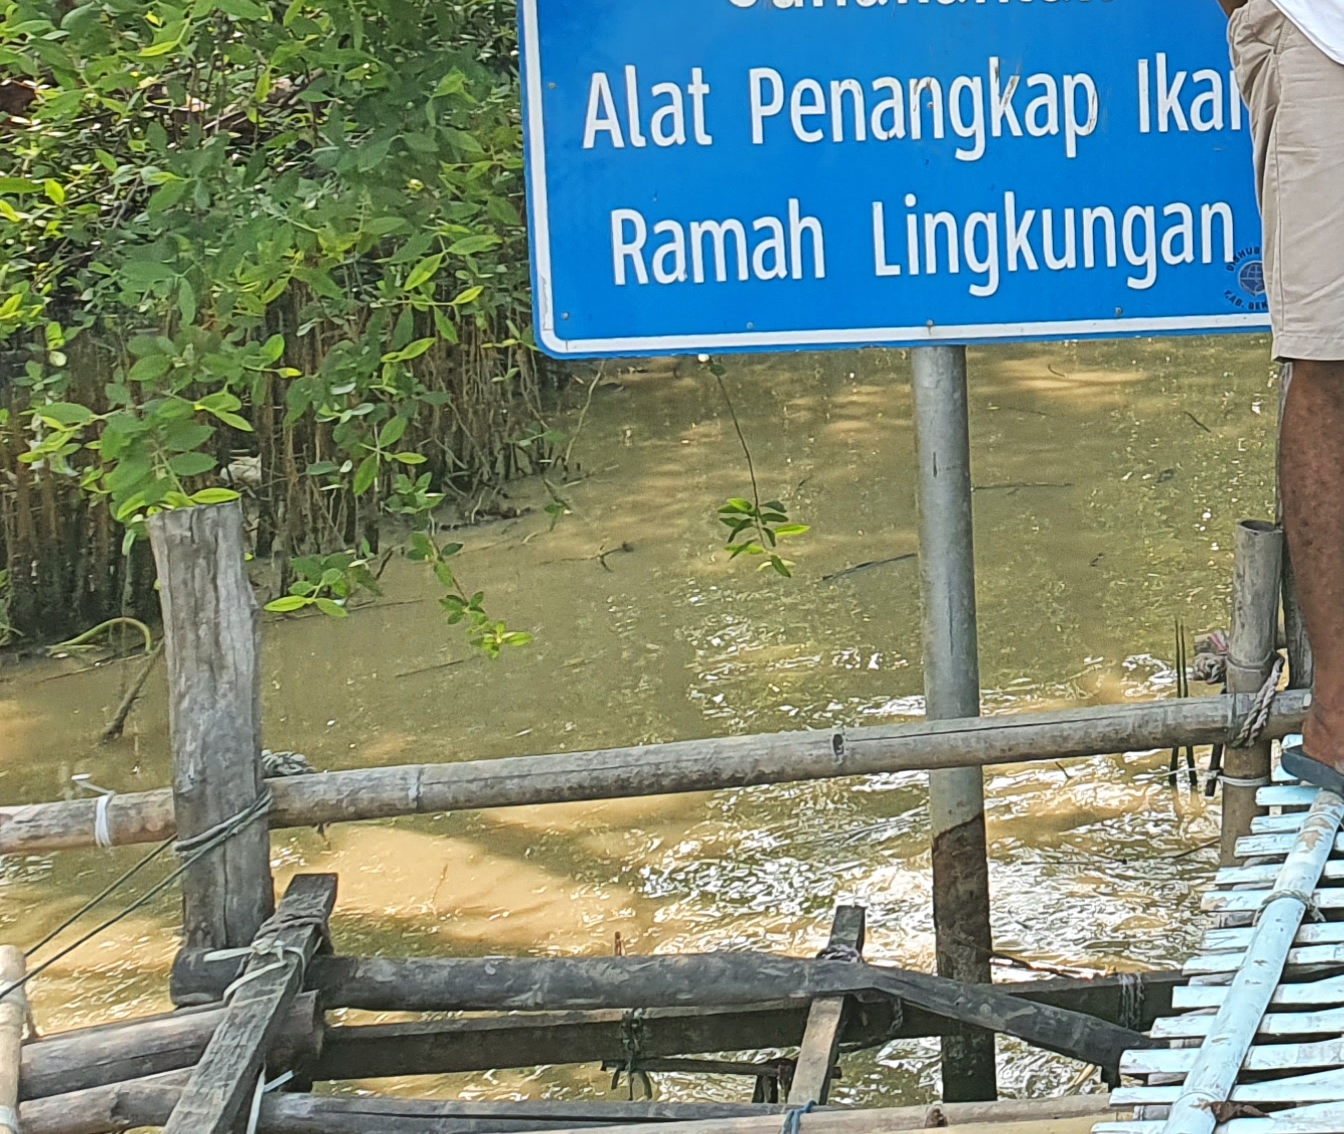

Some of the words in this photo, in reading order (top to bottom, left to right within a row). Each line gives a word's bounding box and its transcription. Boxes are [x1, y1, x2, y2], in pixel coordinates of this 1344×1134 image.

[583, 64, 713, 149] Alat
[750, 57, 1099, 161] Penangkap
[611, 198, 826, 287] Ramah
[873, 191, 1235, 297] Lingkungan
